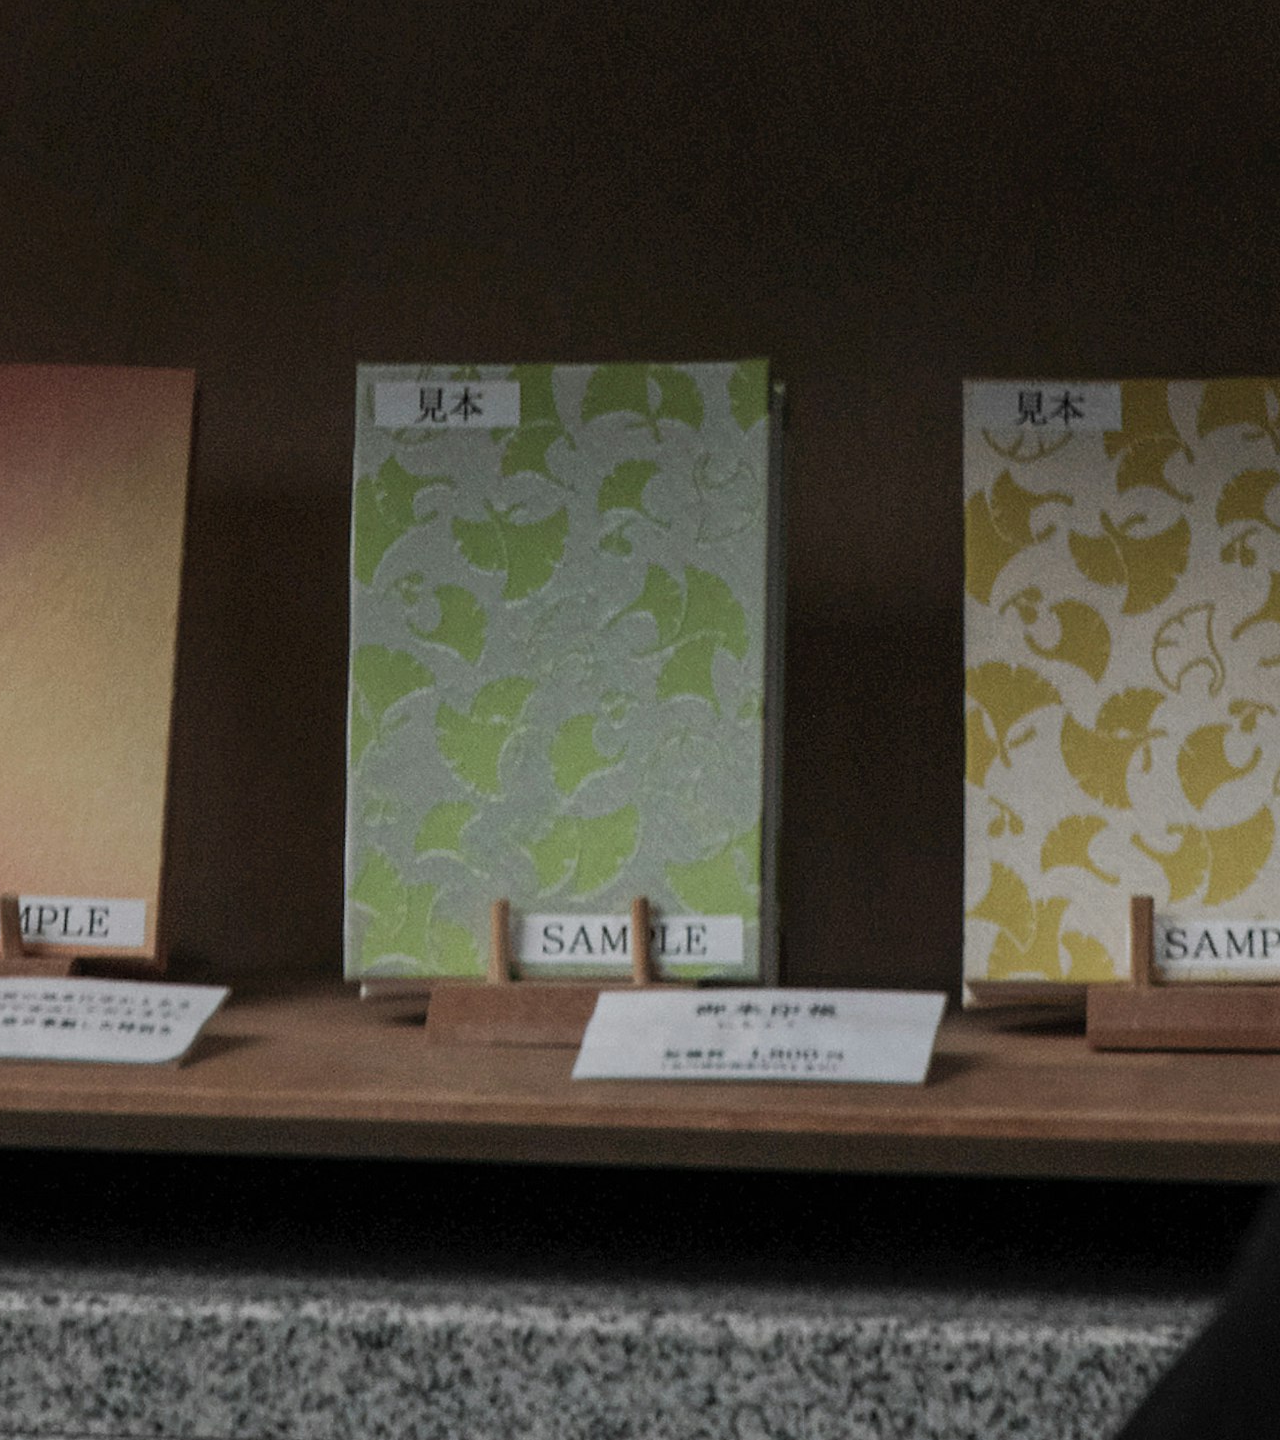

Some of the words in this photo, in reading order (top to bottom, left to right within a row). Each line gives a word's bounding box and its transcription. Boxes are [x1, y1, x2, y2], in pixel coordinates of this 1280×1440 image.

[414, 387, 483, 424] 見本
[1015, 391, 1085, 426] 見本
[541, 924, 707, 956] SAMLE
